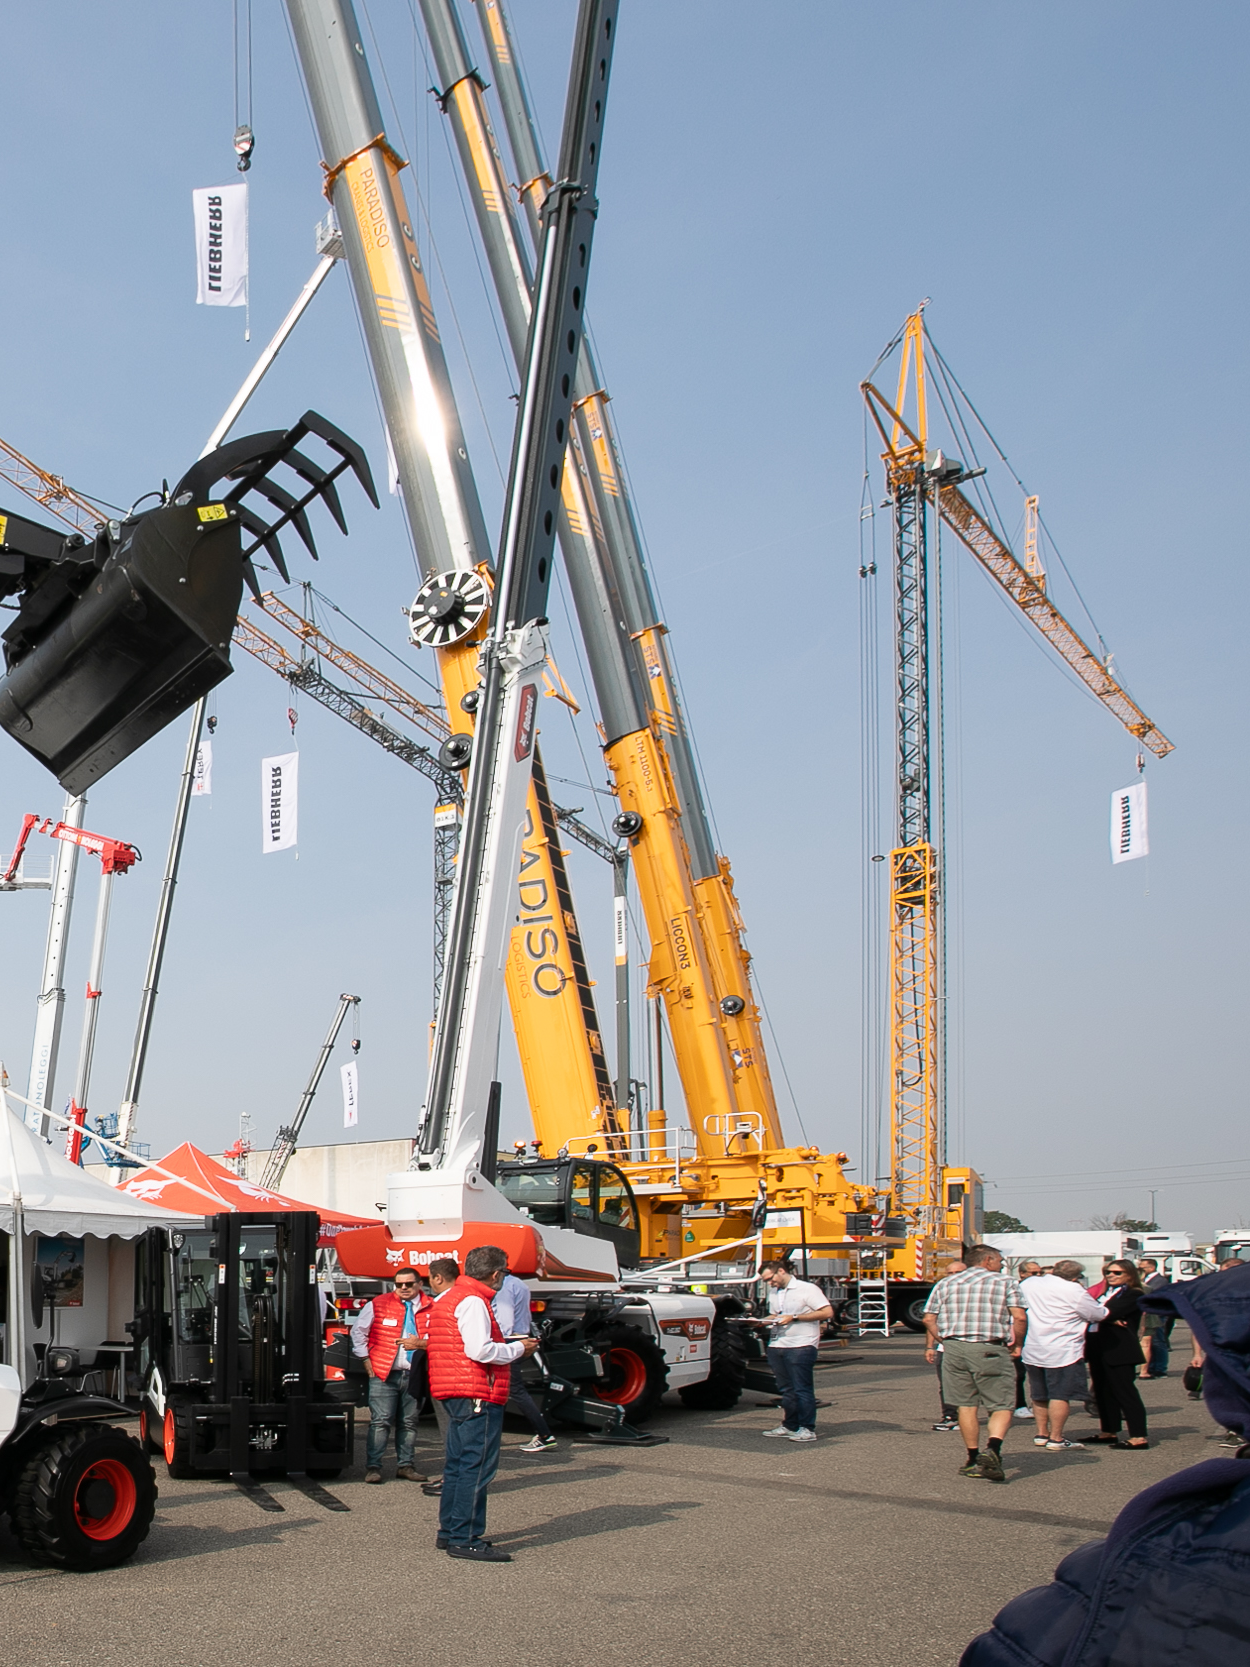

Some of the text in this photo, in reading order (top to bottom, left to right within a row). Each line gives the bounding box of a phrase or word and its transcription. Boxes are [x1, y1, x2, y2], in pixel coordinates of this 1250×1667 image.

[360, 167, 389, 248] PARADISO
[523, 694, 535, 732] Bobcat
[634, 735, 644, 753] LTM
[511, 936, 532, 999] LOGISTICS
[670, 917, 691, 970] LICCON3
